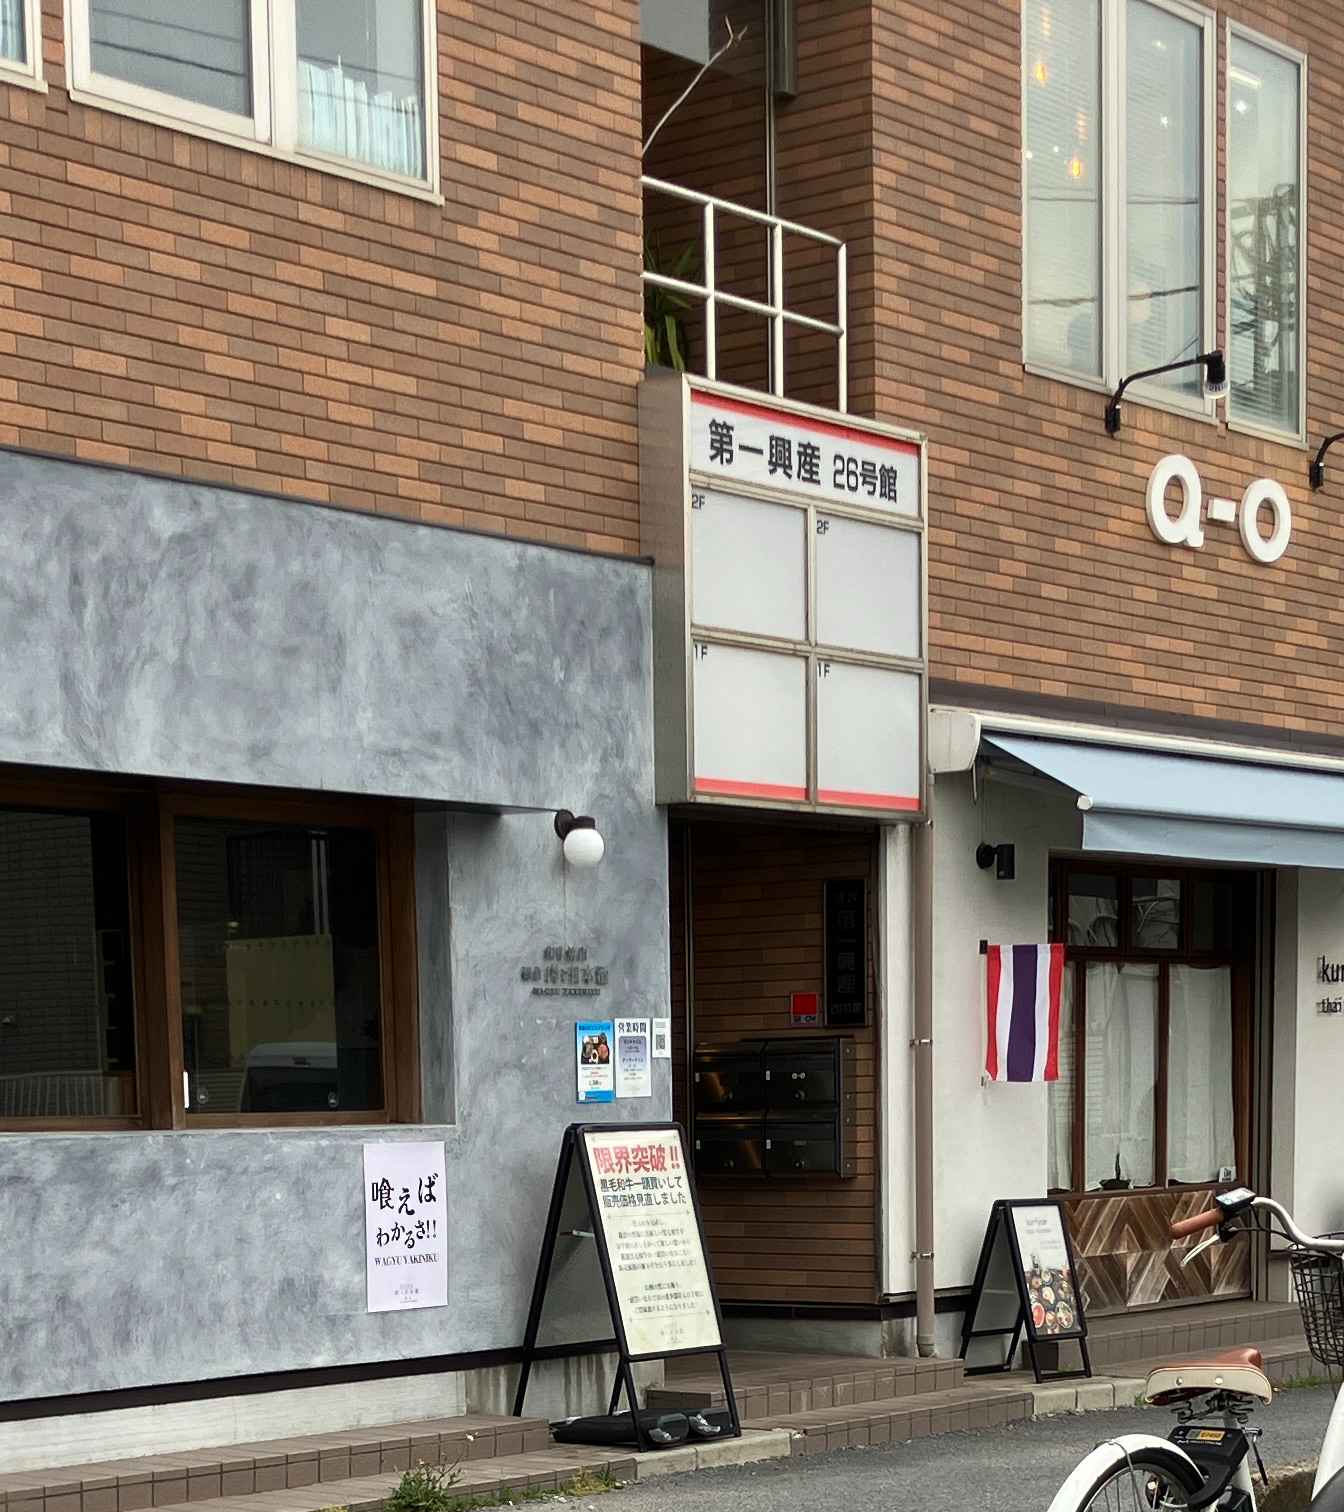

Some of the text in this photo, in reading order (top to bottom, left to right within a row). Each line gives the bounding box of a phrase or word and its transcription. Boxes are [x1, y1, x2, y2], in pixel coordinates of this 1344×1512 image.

[708, 418, 898, 503] 第一興産 26号館
[691, 493, 706, 510] 2F
[816, 519, 830, 535] 2F
[694, 643, 708, 660] 1F
[817, 663, 831, 679] 1F
[371, 1172, 439, 1216] 喰えば
